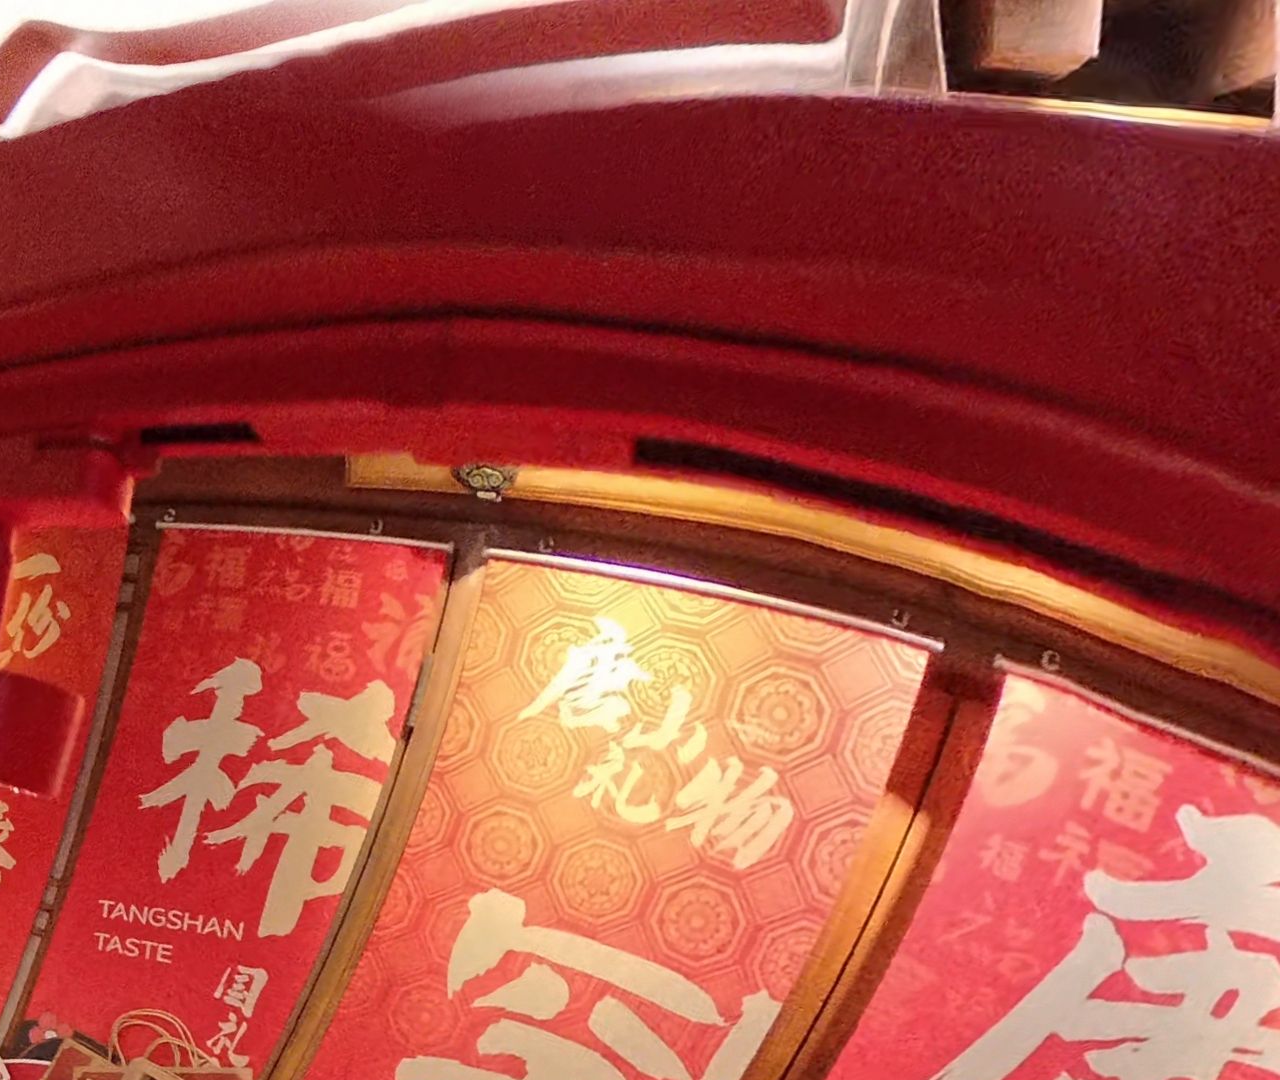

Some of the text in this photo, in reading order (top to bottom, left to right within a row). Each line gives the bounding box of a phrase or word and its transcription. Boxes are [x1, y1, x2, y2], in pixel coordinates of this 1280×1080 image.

[140, 655, 398, 937] 稀
[572, 742, 795, 870] 礼物
[93, 932, 173, 964] TASTE
[98, 899, 245, 940] TANGSHAN
